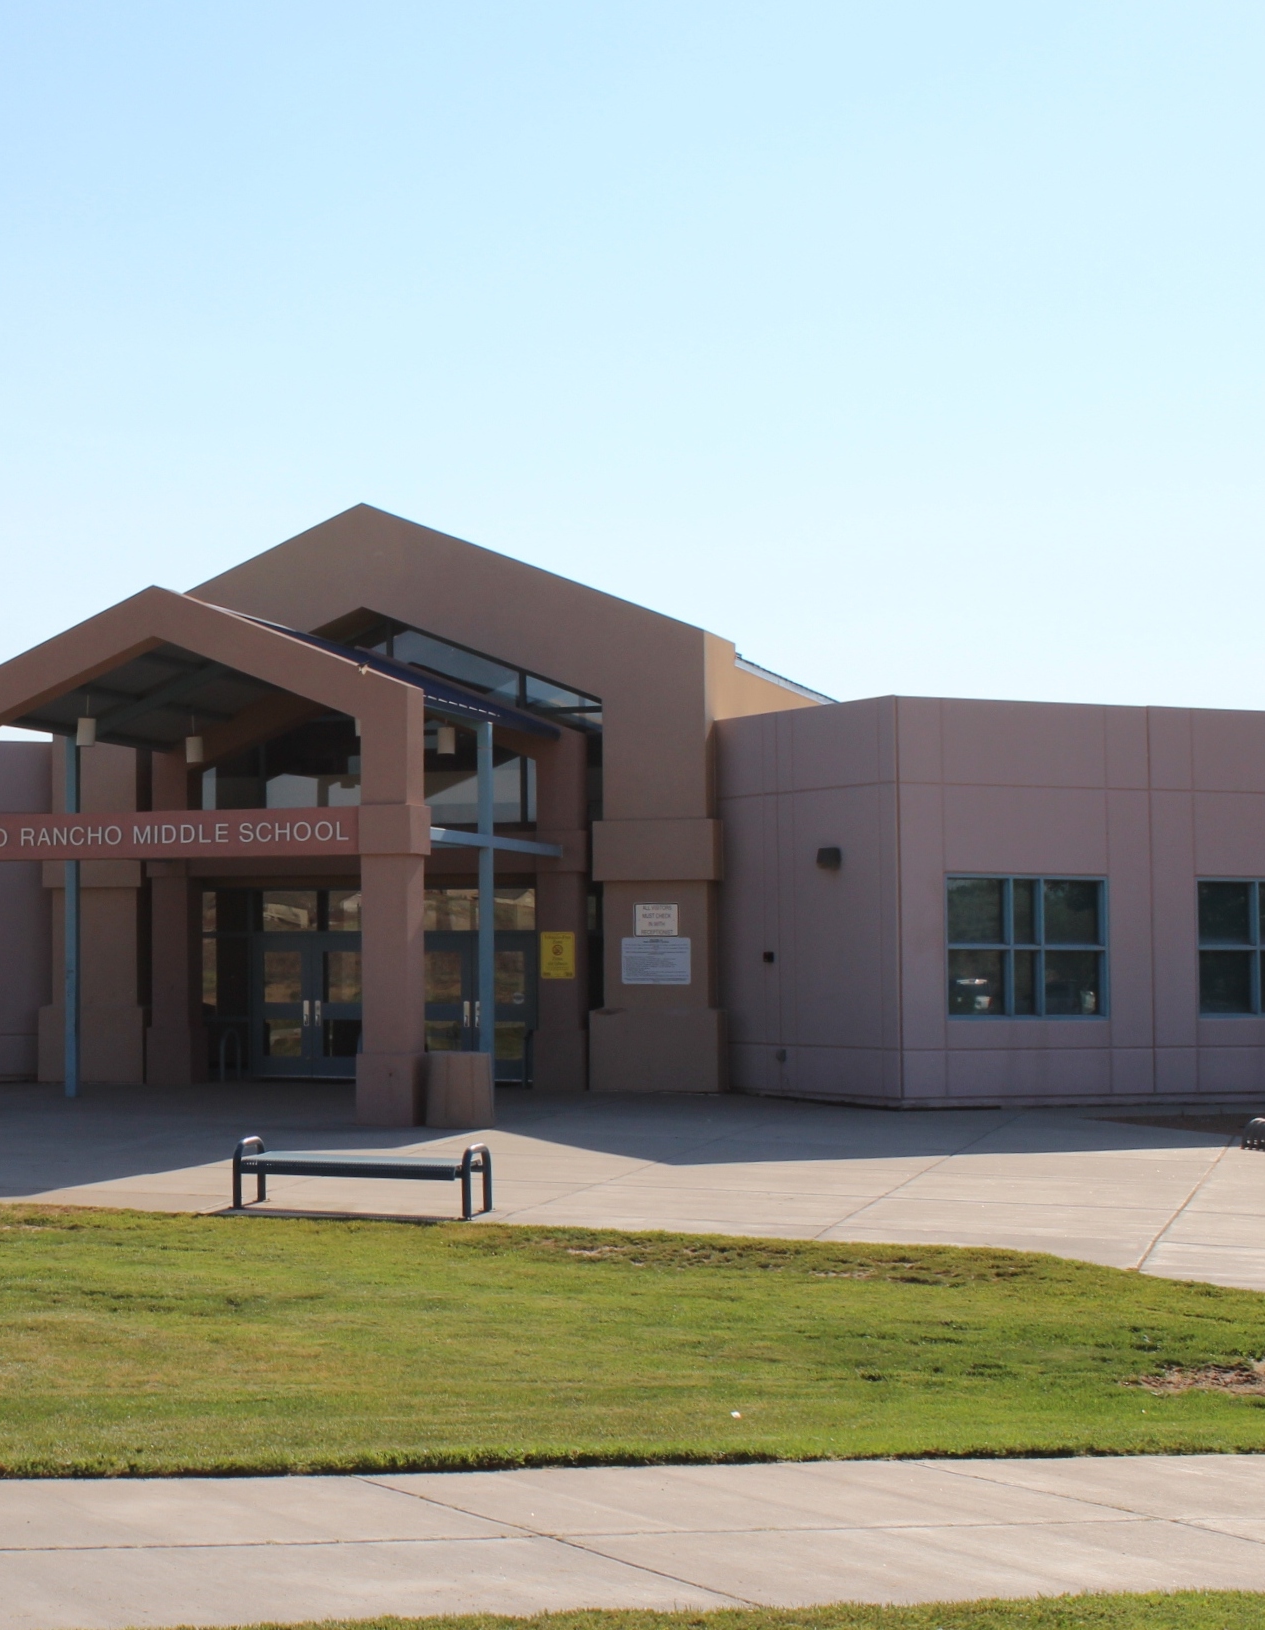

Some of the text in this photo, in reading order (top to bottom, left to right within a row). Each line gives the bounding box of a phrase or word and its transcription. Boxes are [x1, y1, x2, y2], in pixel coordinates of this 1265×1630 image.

[20, 825, 123, 847] RANCHO
[132, 823, 230, 845] MIDDLE
[238, 821, 350, 843] SCHOOL
